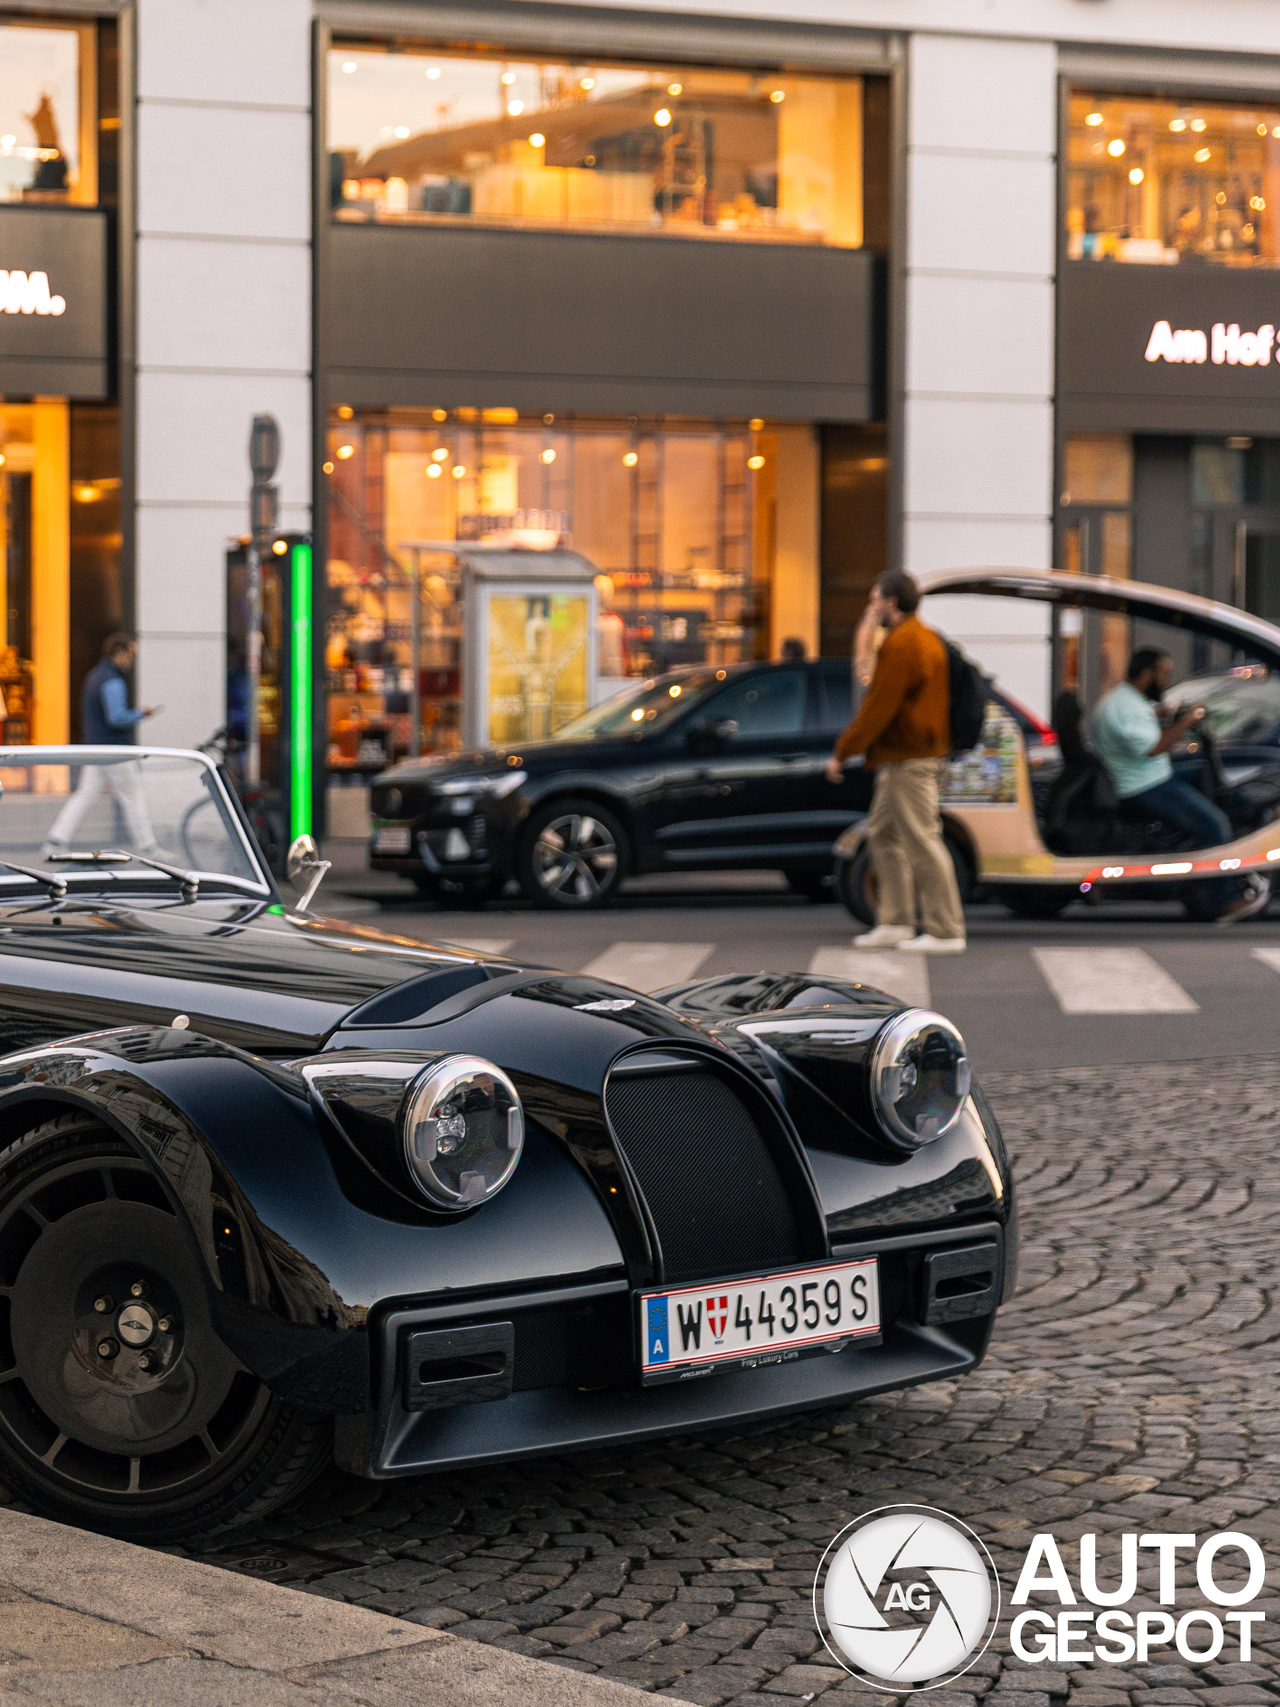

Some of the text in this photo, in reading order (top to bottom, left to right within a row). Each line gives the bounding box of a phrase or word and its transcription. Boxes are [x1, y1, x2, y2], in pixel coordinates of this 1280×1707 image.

[1144, 320, 1208, 364] Am
[1211, 322, 1275, 366] Hof
[677, 1274, 868, 1351] W 44359 S
[653, 1338, 664, 1354] A
[758, 1352, 782, 1365] Luxury
[783, 1350, 799, 1360] Cars
